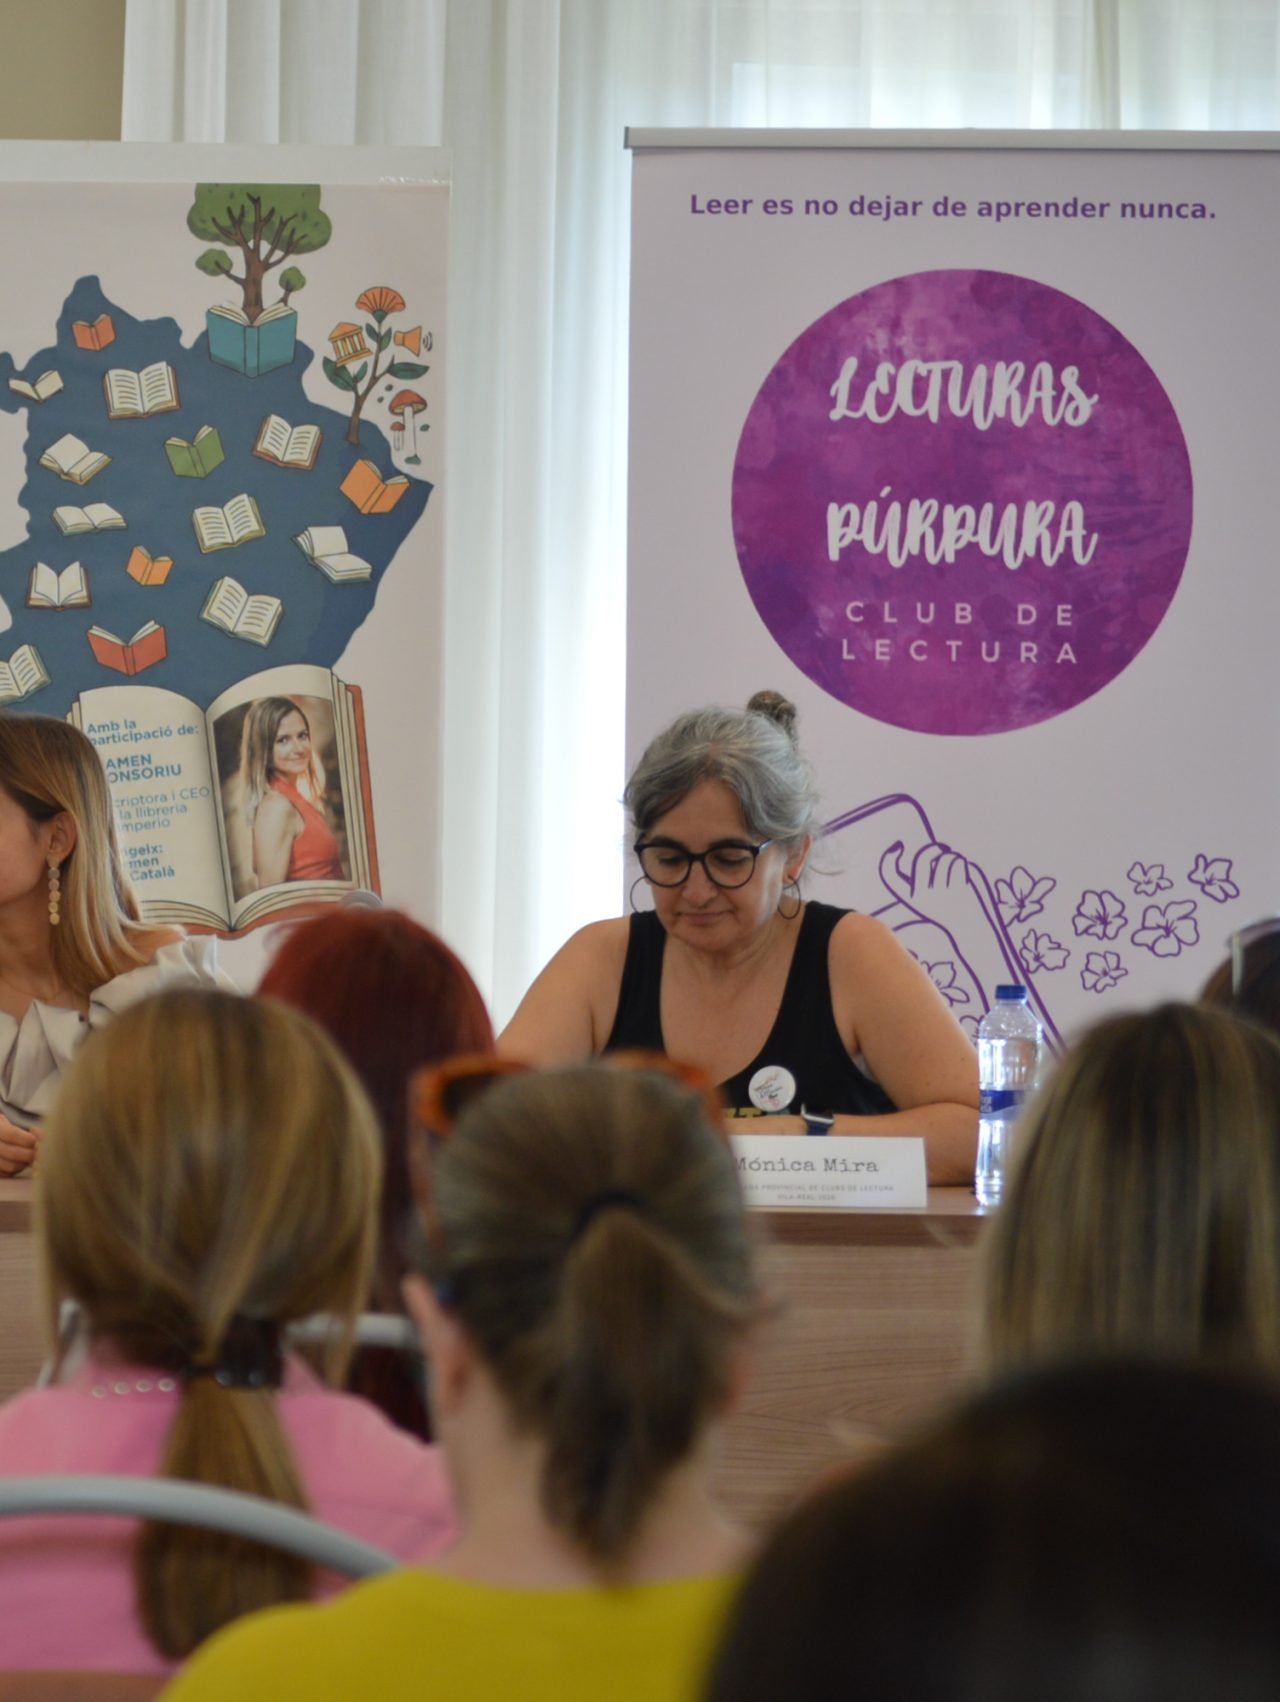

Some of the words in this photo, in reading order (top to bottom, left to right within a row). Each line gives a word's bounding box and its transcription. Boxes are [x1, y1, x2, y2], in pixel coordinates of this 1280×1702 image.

[690, 194, 753, 215] Leer
[762, 199, 794, 215] es
[804, 199, 838, 215] no
[848, 195, 923, 222] dejar
[932, 196, 967, 217] de
[977, 197, 1110, 223] aprender
[1120, 201, 1216, 219] nunca.
[828, 356, 1100, 431] LECTURAS
[826, 486, 1099, 570] PÚRPURA
[845, 602, 973, 626] CLUB
[1016, 604, 1073, 626] DE
[841, 639, 1077, 664] LECTURA
[87, 720, 120, 734] Amb
[124, 718, 137, 730] la
[177, 723, 200, 736] de:
[106, 754, 152, 769] AMEN
[107, 763, 182, 783] ONSORIU
[114, 793, 168, 808] criptora
[179, 786, 210, 800] CEO
[122, 817, 170, 833] mperio
[735, 1156, 817, 1173] Mónica
[824, 1158, 880, 1173] Mira
